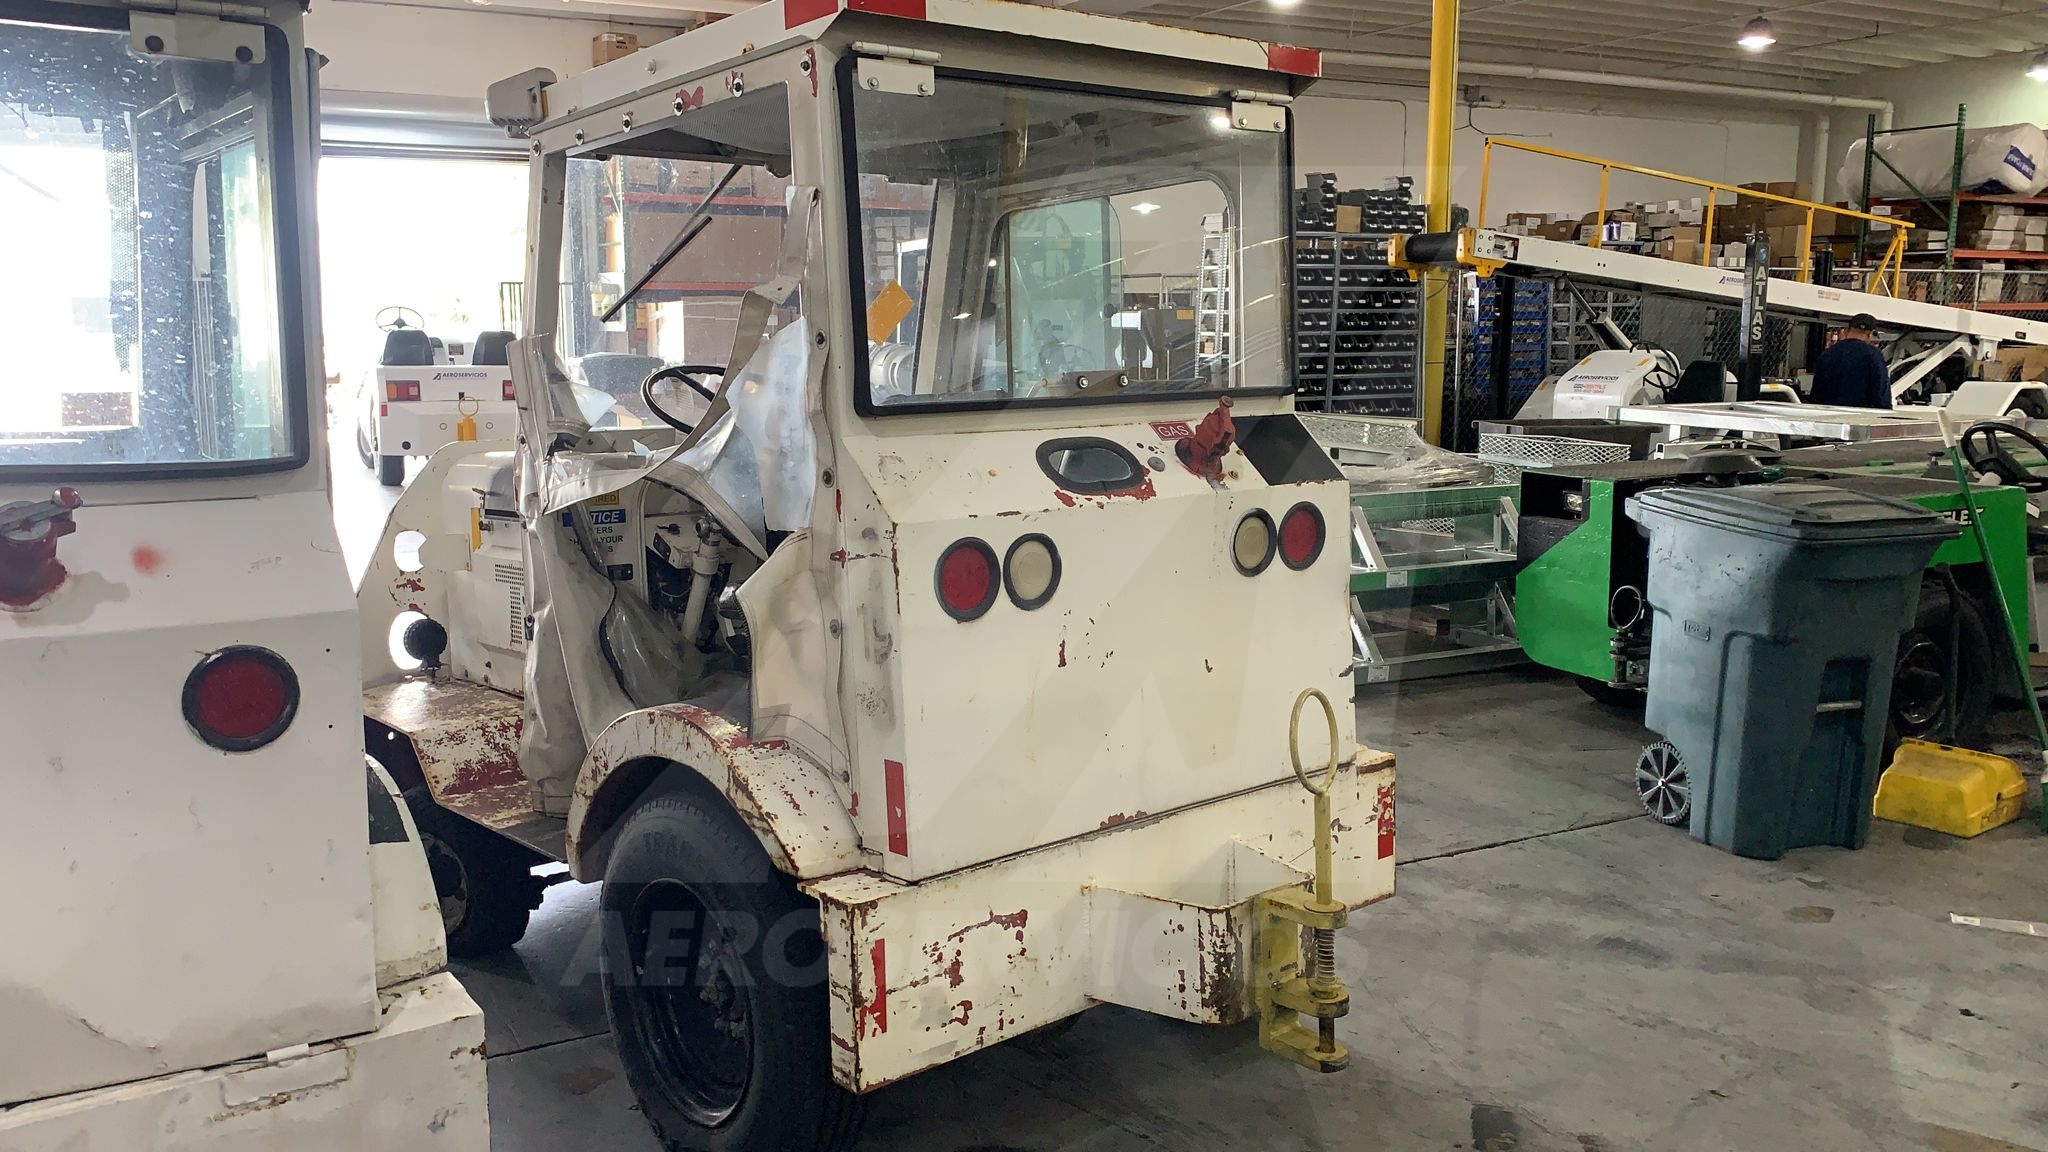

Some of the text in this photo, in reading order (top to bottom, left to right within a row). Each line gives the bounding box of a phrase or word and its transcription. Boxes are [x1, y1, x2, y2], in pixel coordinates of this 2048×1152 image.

[1752, 265, 1767, 341] ATLAS
[1158, 425, 1190, 437] GAS
[590, 510, 620, 524] TICE
